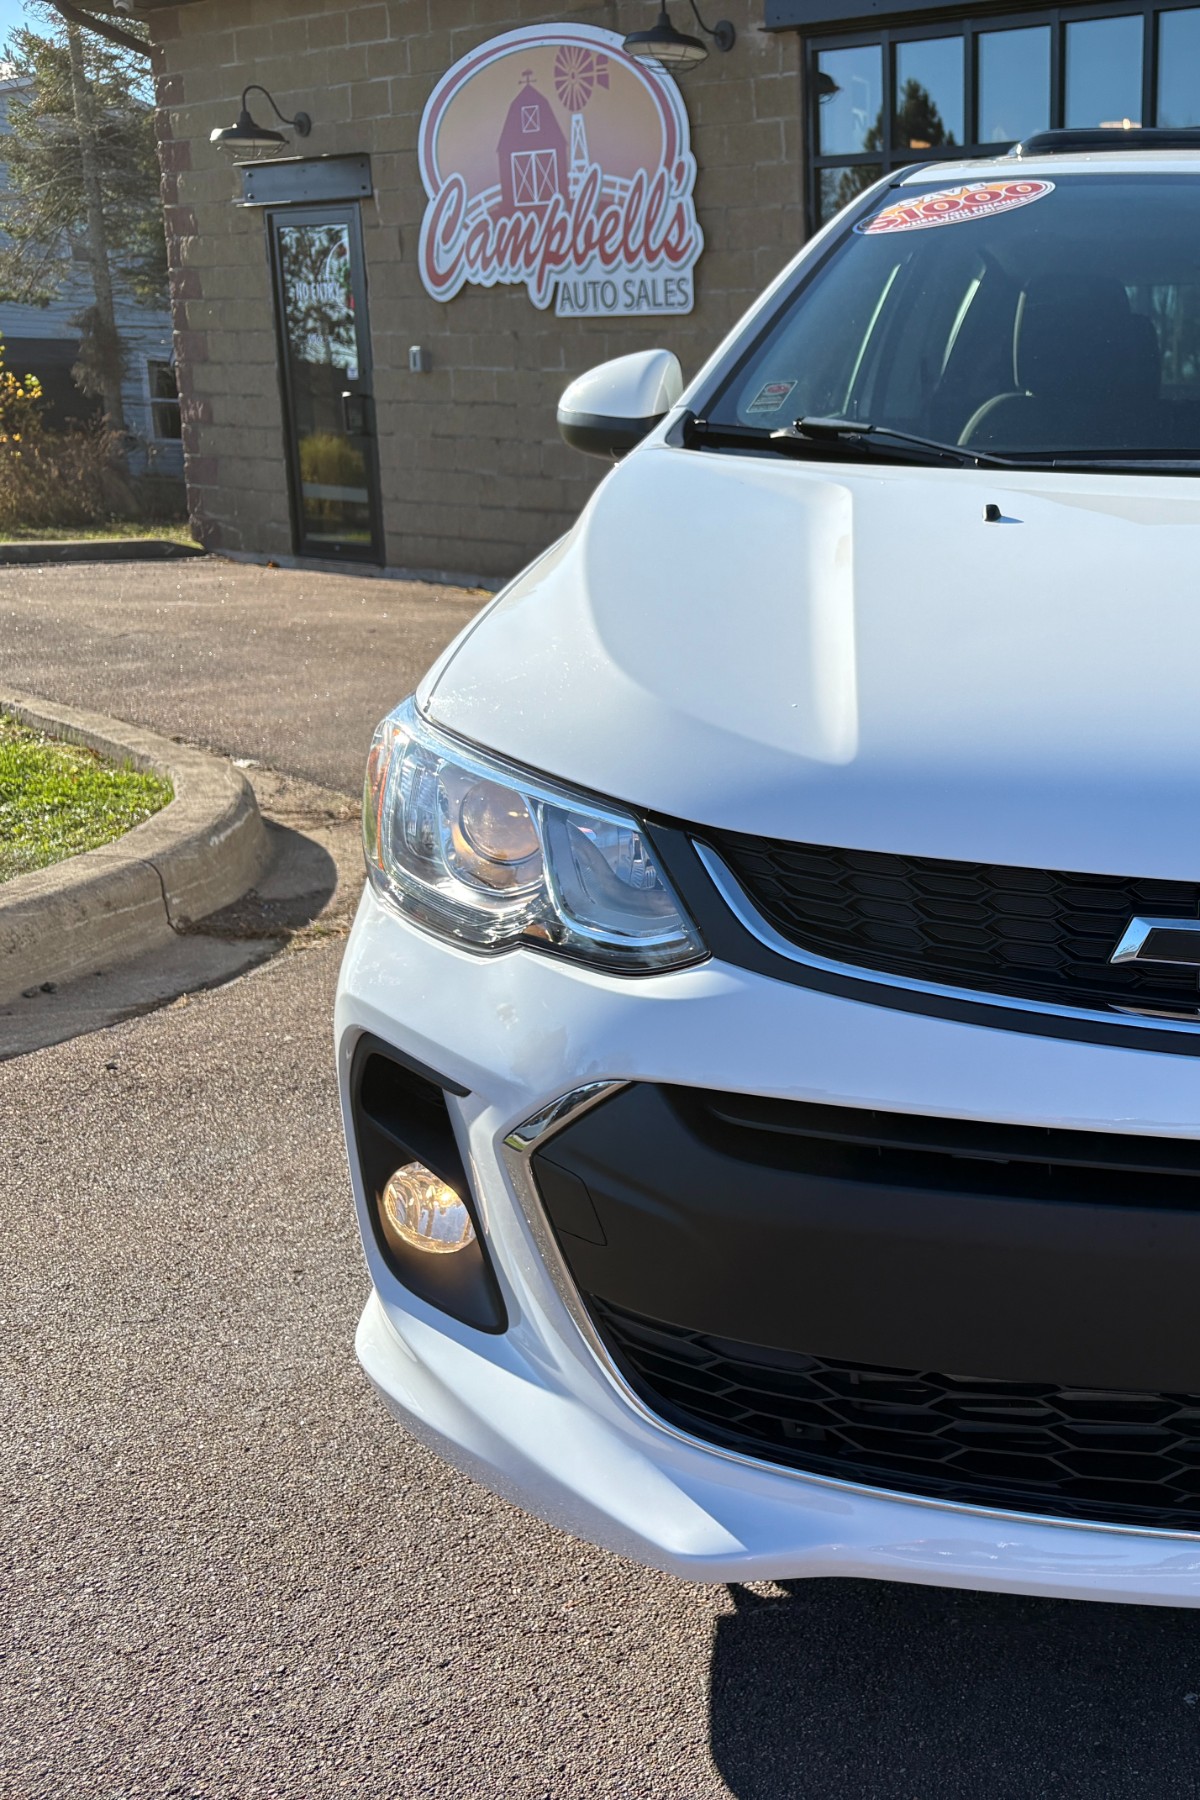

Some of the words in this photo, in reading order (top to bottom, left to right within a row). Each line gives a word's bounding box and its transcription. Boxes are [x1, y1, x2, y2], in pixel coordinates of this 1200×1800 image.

[897, 182, 986, 207] SAVE
[941, 208, 970, 220] YOU
[972, 196, 1028, 211] FINANCE
[426, 160, 694, 295] Campbell's
[295, 282, 309, 301] NO
[311, 281, 340, 303] ENTRY
[559, 279, 618, 312] AUTO
[623, 277, 691, 310] SALES
